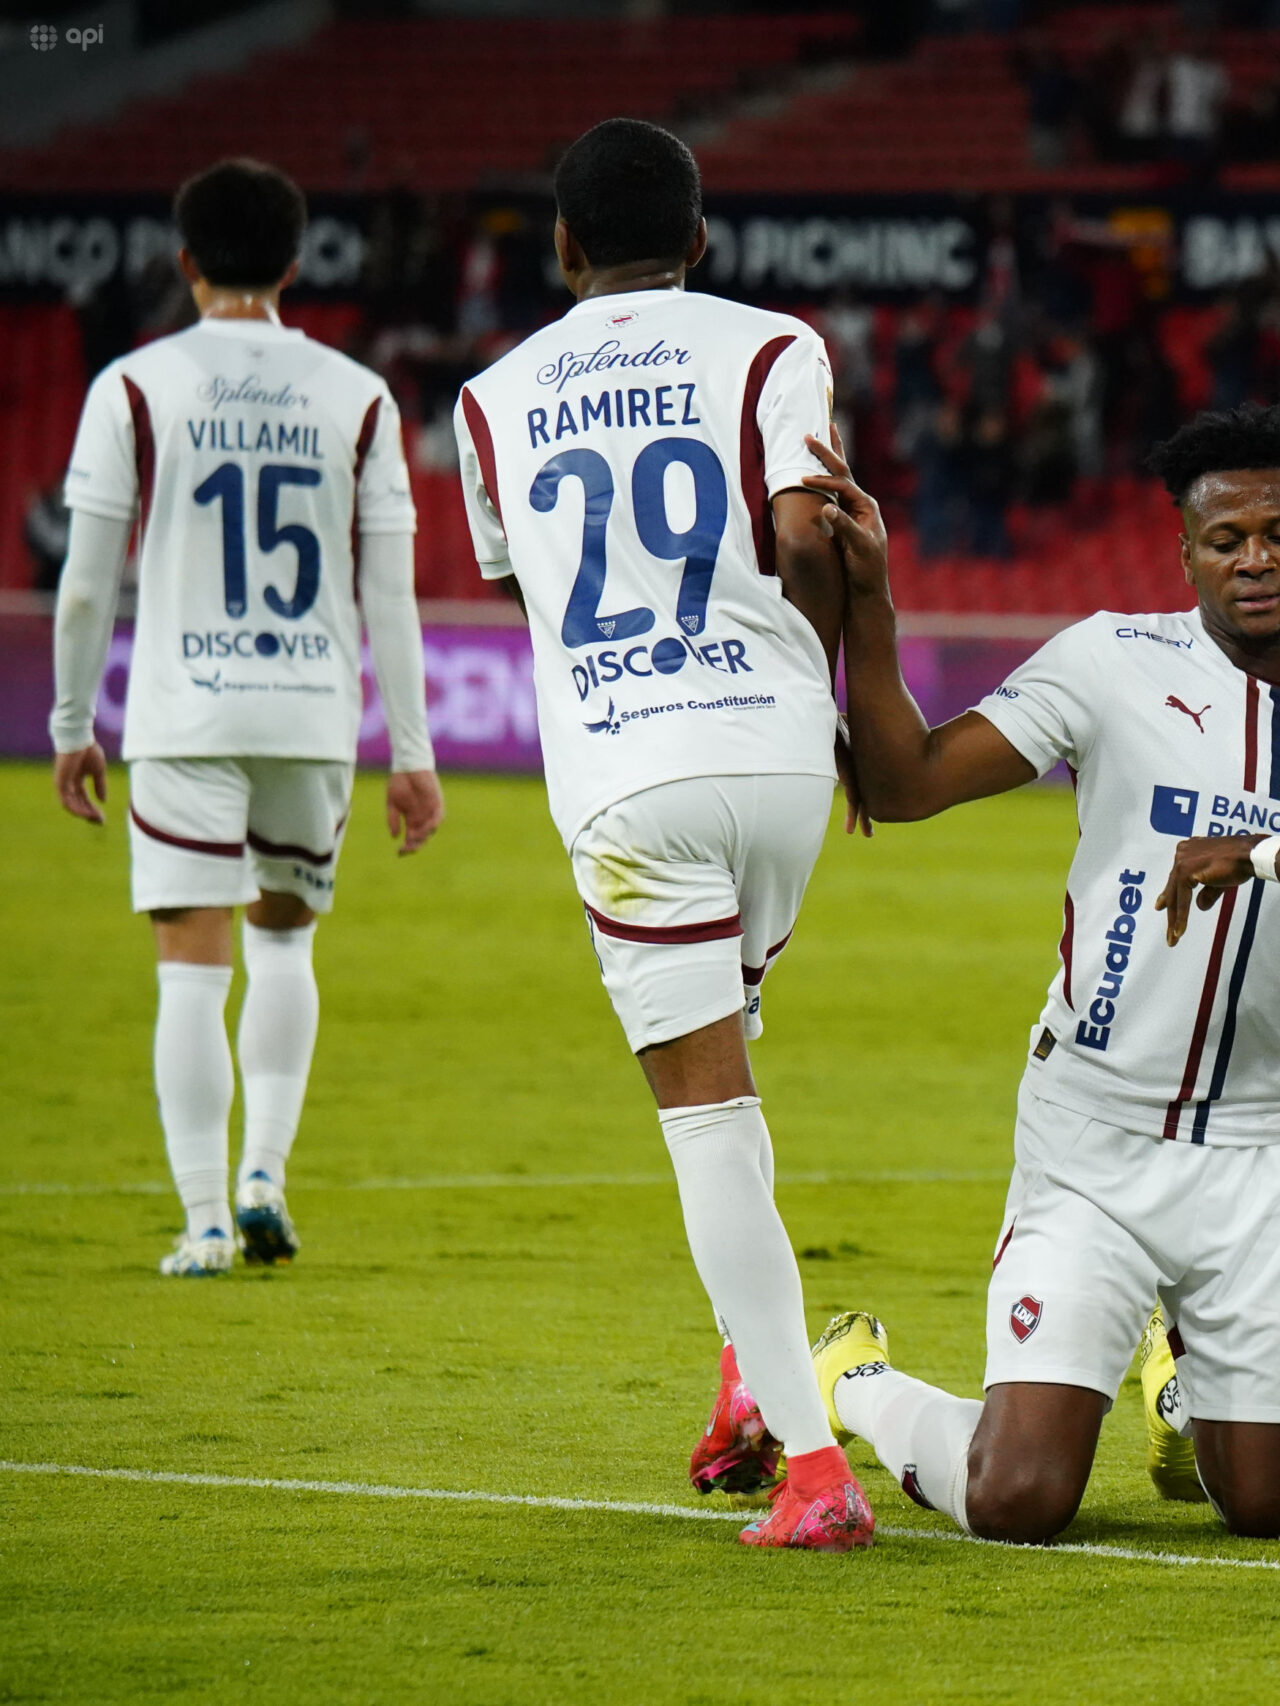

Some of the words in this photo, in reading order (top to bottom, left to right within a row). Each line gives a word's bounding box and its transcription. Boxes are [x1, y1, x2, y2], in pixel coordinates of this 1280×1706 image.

[537, 340, 692, 394] Splendor
[199, 375, 309, 411] Splendor
[527, 383, 701, 449] RAMIREZ
[187, 419, 325, 460] VILLAMIL
[193, 462, 323, 620] 15
[529, 437, 728, 648] 29
[182, 630, 333, 661] DISCOVER
[1115, 628, 1194, 650] CHERY
[571, 635, 754, 702] DISCOVER
[620, 702, 684, 723] Seguros
[687, 694, 776, 711] Constitución
[1074, 868, 1146, 1051] Ecuabet
[1013, 1304, 1036, 1326] LDU
